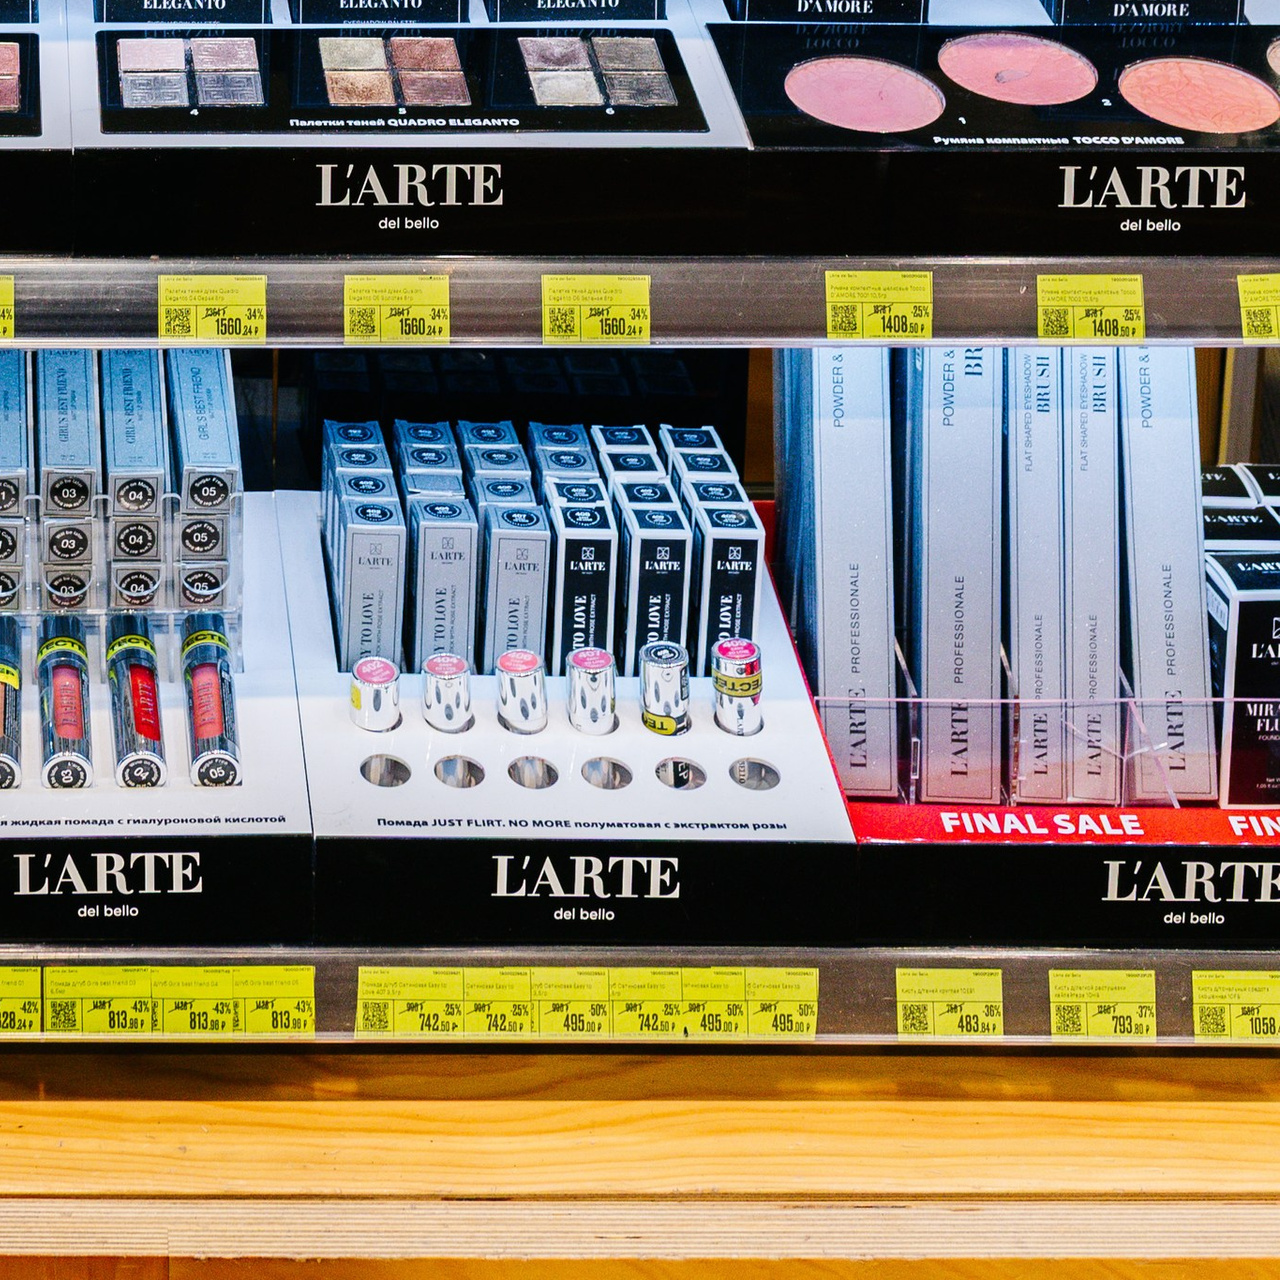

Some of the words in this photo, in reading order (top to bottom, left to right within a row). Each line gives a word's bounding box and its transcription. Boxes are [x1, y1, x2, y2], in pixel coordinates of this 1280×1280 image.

[798, 0, 873, 13] D'AMORE
[933, 136, 984, 145] Румяна
[315, 164, 503, 207] L'ARTE
[1058, 166, 1246, 209] L'ARTE
[943, 373, 955, 426] POWDER
[1036, 357, 1050, 412] BRUSH
[850, 562, 861, 674] PROFESSIONALE
[127, 816, 221, 826] гиалуроновой
[377, 818, 428, 827] Помада
[432, 819, 463, 827] JUST
[467, 819, 505, 827] FLIRT.
[574, 822, 661, 830] полуматовая
[752, 823, 787, 831] розы
[940, 812, 1049, 834] FINAL
[1053, 814, 1144, 835] SALE
[13, 852, 202, 895] L'ARTE
[491, 856, 680, 898] L'ARTE
[1164, 912, 1185, 924] del
[1190, 912, 1225, 924] bello
